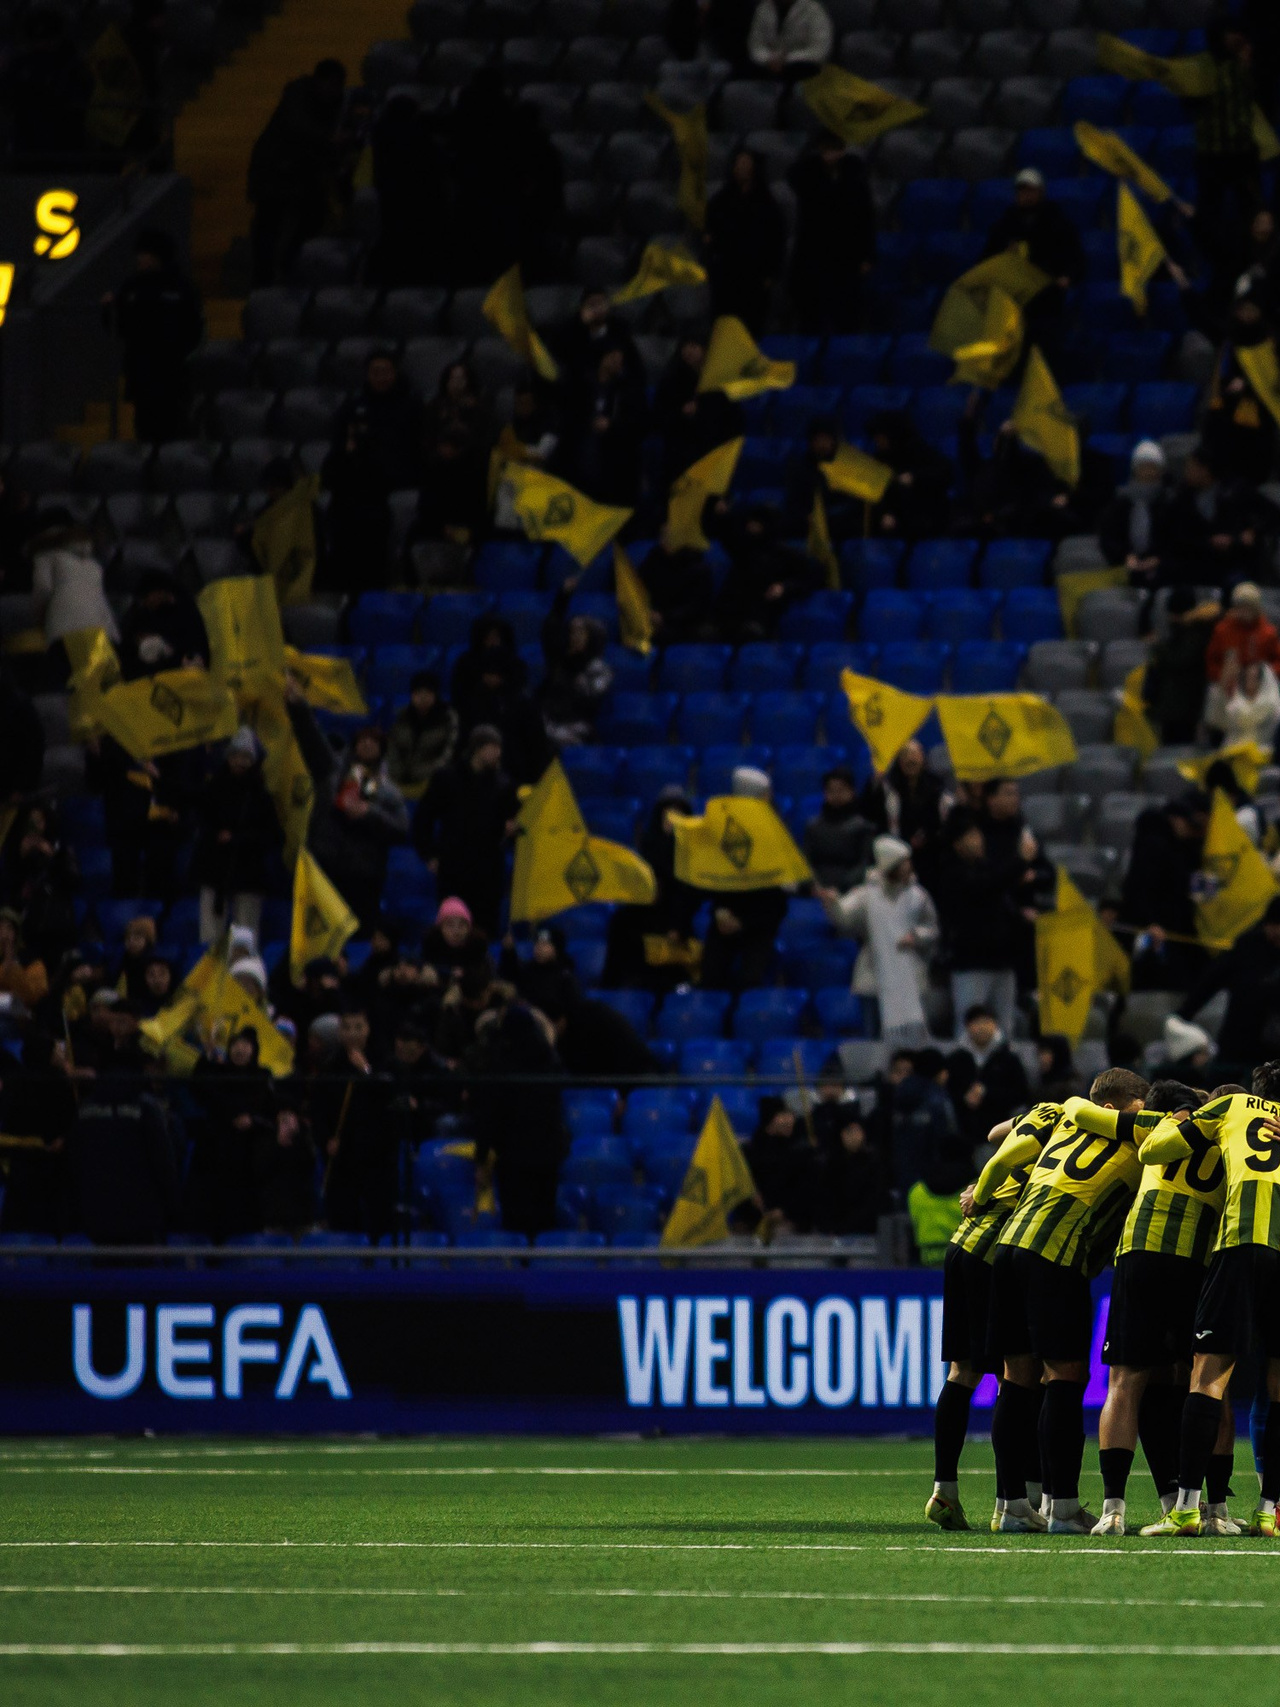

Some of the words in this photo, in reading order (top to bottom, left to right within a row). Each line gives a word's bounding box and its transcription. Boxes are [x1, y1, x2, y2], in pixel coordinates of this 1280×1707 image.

[33, 186, 82, 260] S
[1037, 1128, 1122, 1181] 20
[71, 1301, 353, 1400] UEFA
